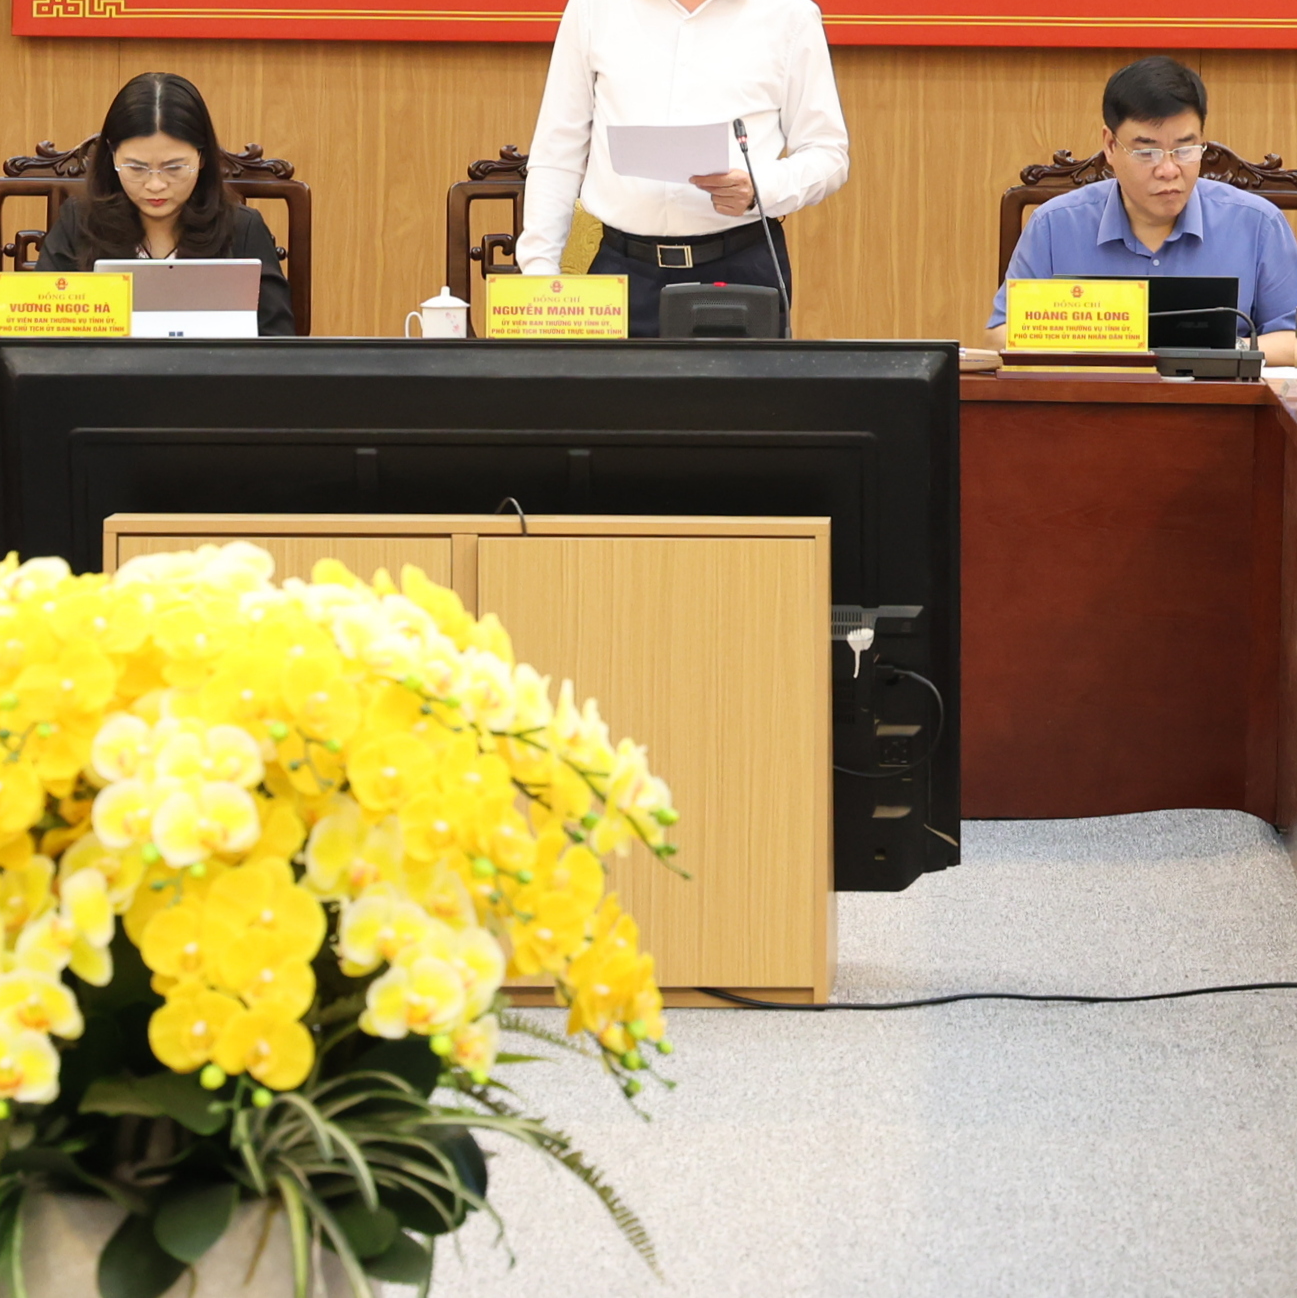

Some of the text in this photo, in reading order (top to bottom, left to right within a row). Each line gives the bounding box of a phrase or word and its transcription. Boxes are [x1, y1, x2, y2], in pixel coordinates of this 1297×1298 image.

[10, 302, 110, 315] VƯƠNG NGỌC HÀ
[493, 303, 621, 317] NGUYỄN MẠNH TUẤN
[1025, 309, 1129, 320] HOÀNG GIA LONG
